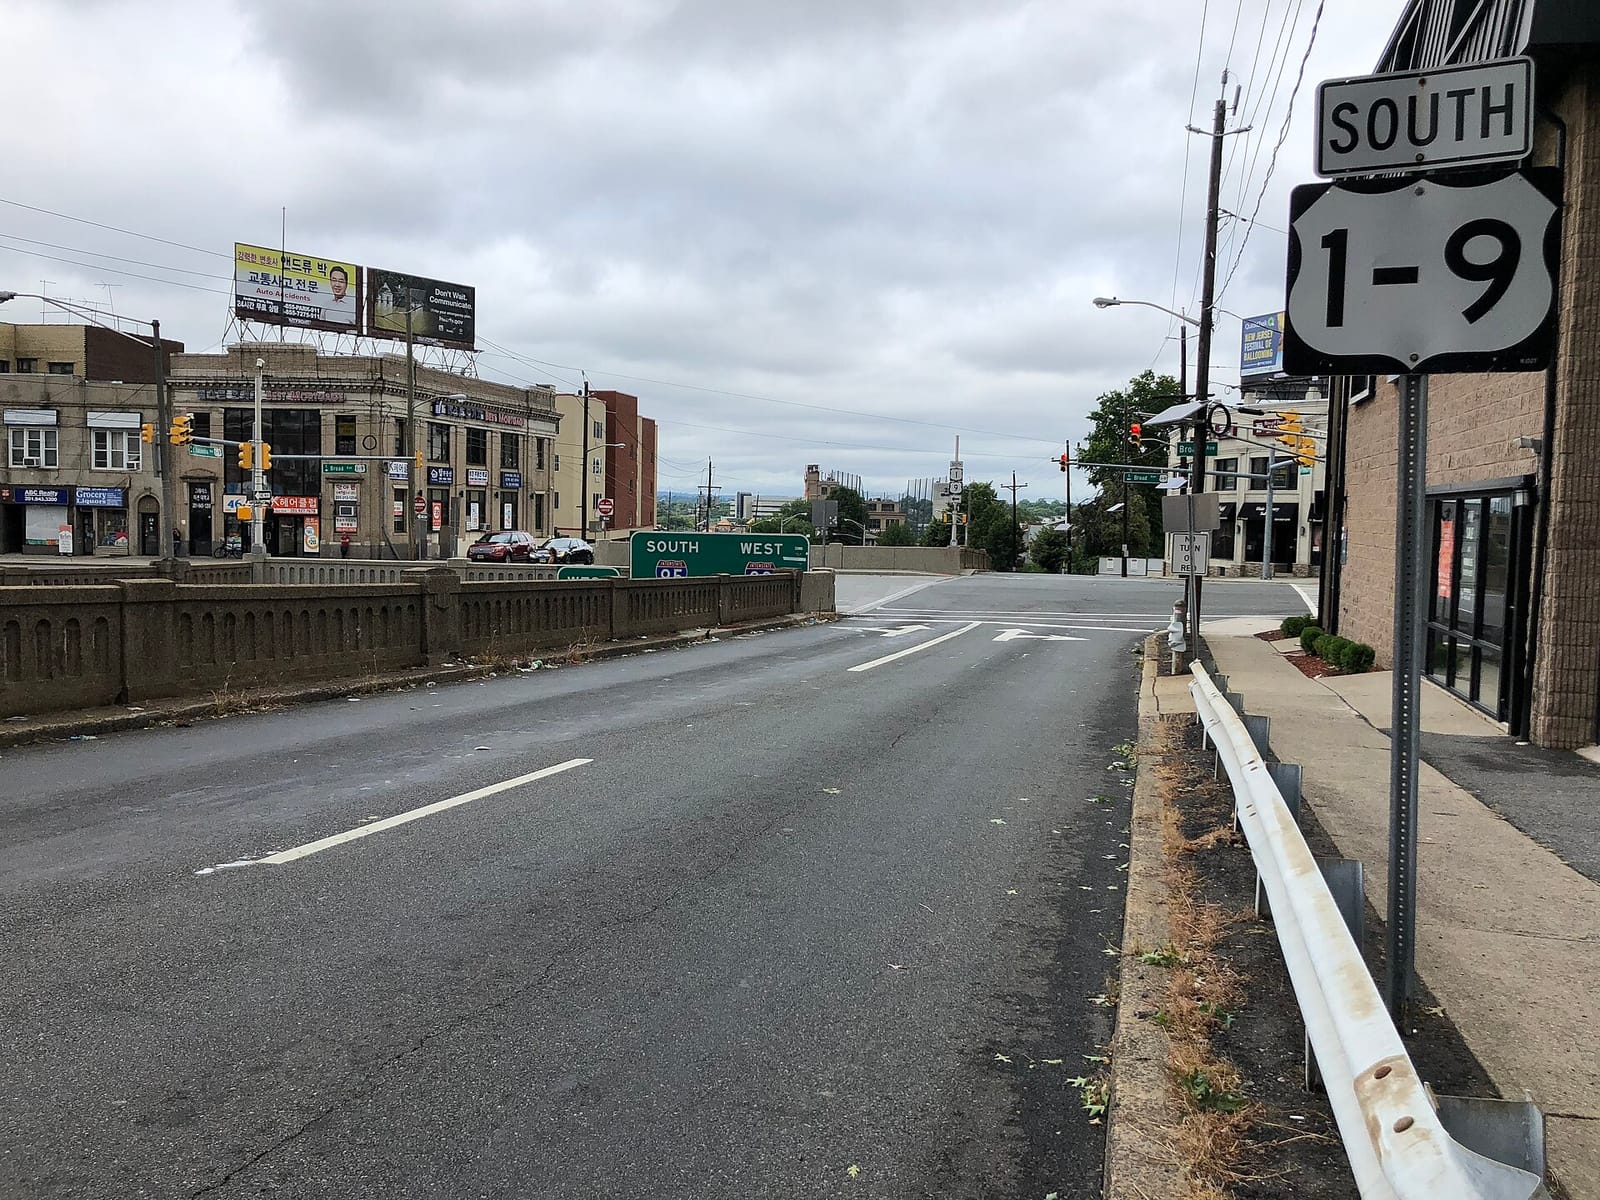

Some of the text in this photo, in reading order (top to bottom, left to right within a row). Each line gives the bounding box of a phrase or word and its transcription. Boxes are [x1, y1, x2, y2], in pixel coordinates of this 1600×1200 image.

[1328, 82, 1515, 155] SOUTH
[316, 261, 328, 277] 박
[1320, 217, 1522, 328] 1-9
[256, 287, 311, 302] Auto Acidents
[434, 288, 468, 301] Don't Wait.
[1256, 329, 1273, 341] JERSEY
[1264, 338, 1272, 349] OF
[1206, 443, 1216, 452] Ave
[75, 490, 107, 499] Grocery
[646, 540, 784, 555] SOUTH WEST
[1180, 544, 1201, 552] TUN
